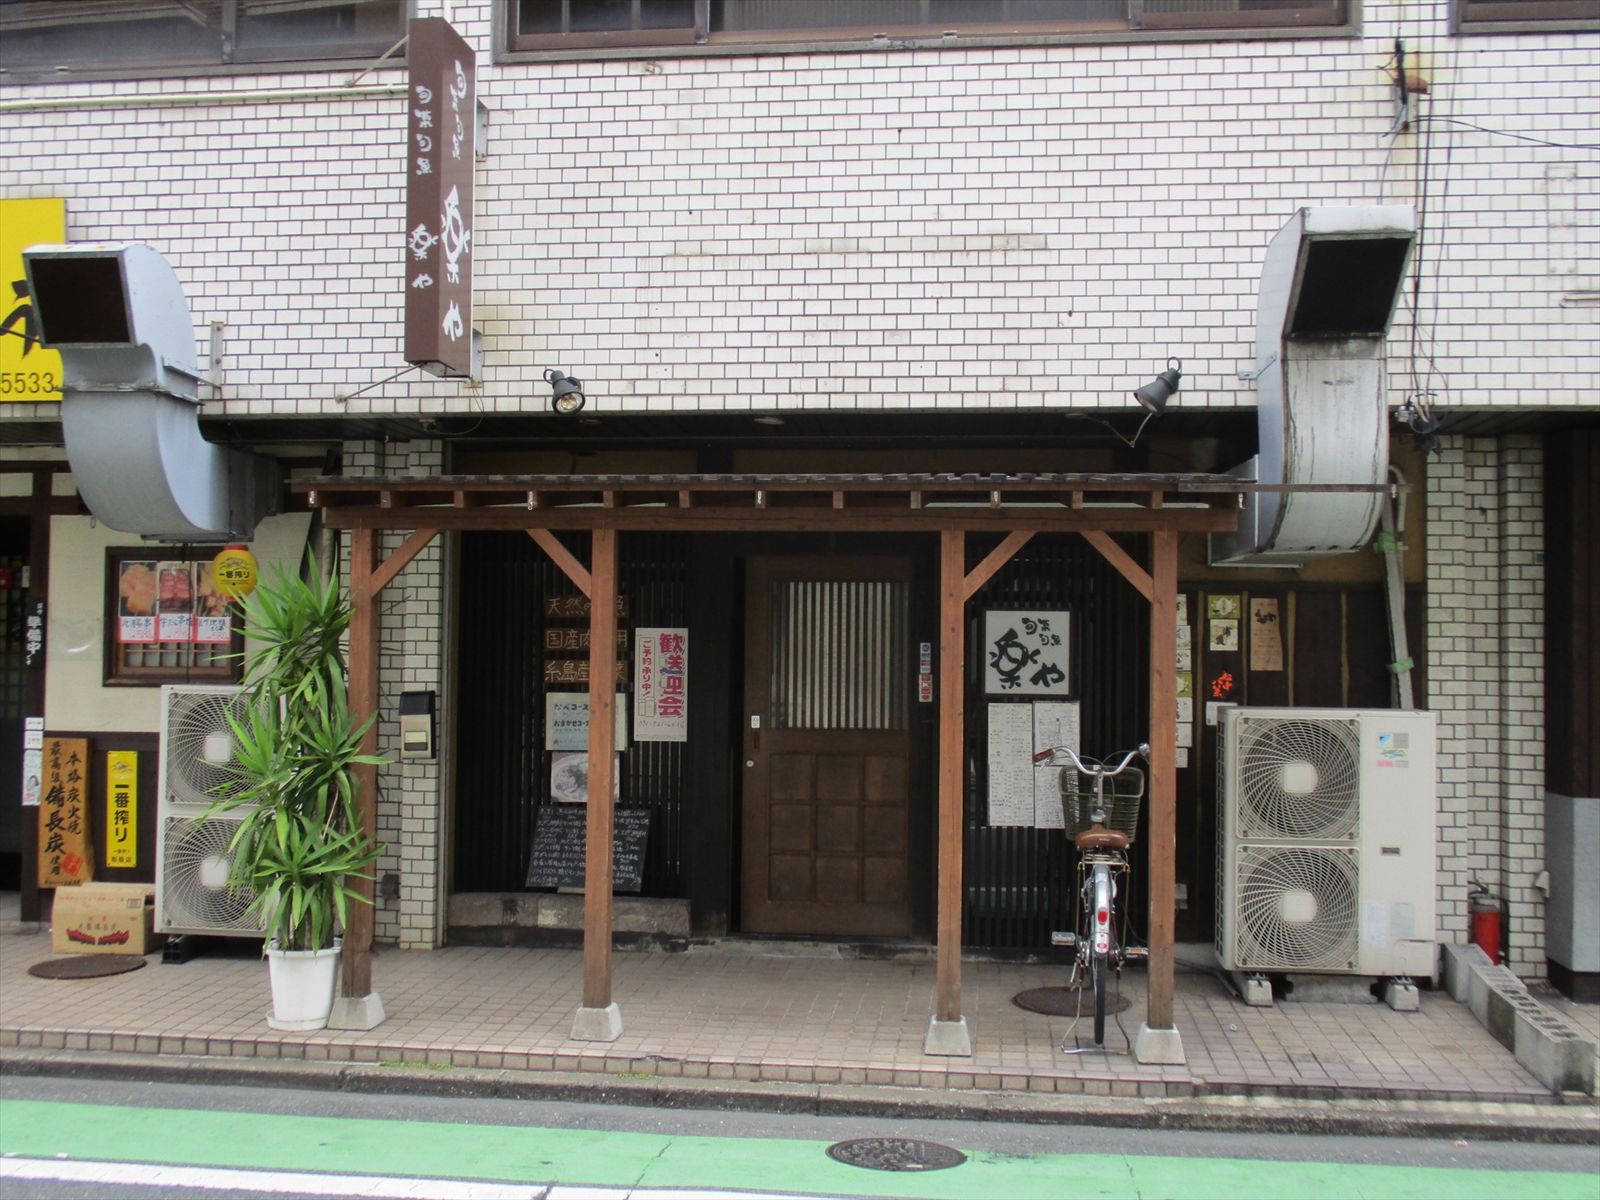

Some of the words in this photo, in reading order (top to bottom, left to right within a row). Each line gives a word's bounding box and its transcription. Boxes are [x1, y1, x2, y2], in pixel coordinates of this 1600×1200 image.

[1, 372, 55, 395] 5533
[114, 784, 130, 843] 一番搾り
